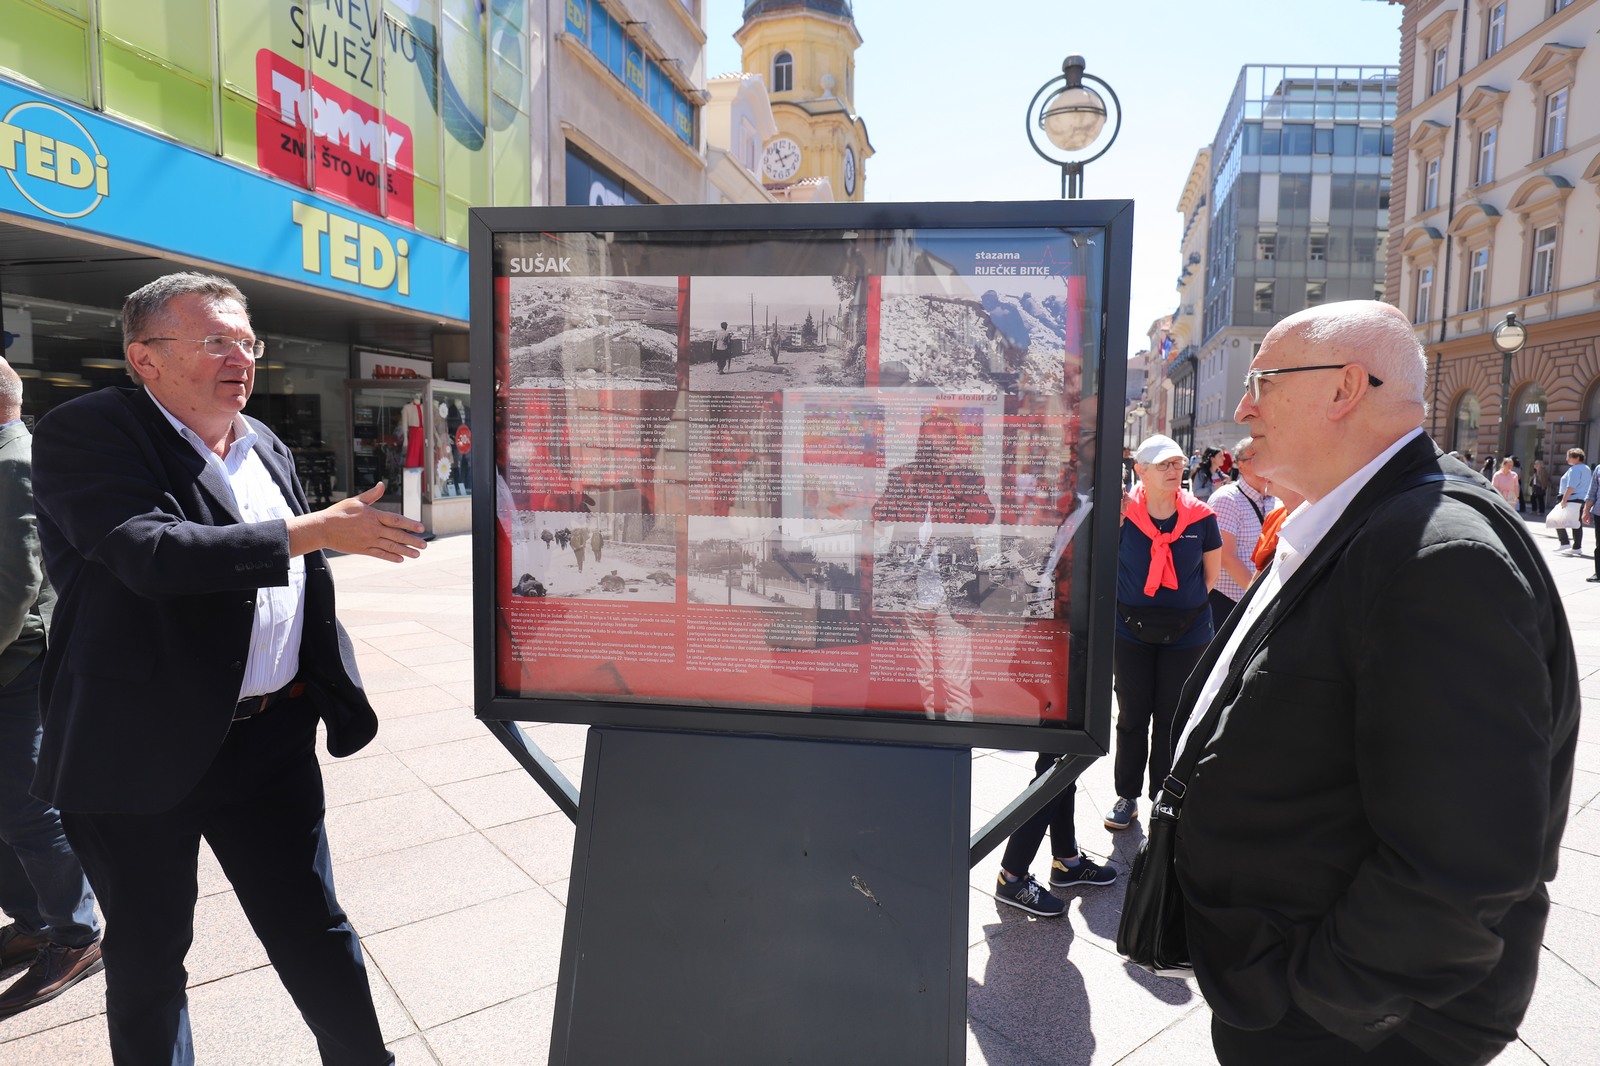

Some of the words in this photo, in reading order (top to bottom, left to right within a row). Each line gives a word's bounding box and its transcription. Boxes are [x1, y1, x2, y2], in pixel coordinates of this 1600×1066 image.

[566, 0, 586, 35] EDi
[290, 5, 387, 96] SVJEŽ
[272, 69, 404, 170] TOMMY
[0, 120, 110, 197] TEDi
[321, 145, 351, 177] ŠTO
[292, 199, 411, 298] TEDi
[510, 252, 571, 273] SUŠAK
[975, 251, 1020, 260] stazama
[975, 264, 1017, 275] RIJEČKE
[1020, 266, 1050, 276] BITKE
